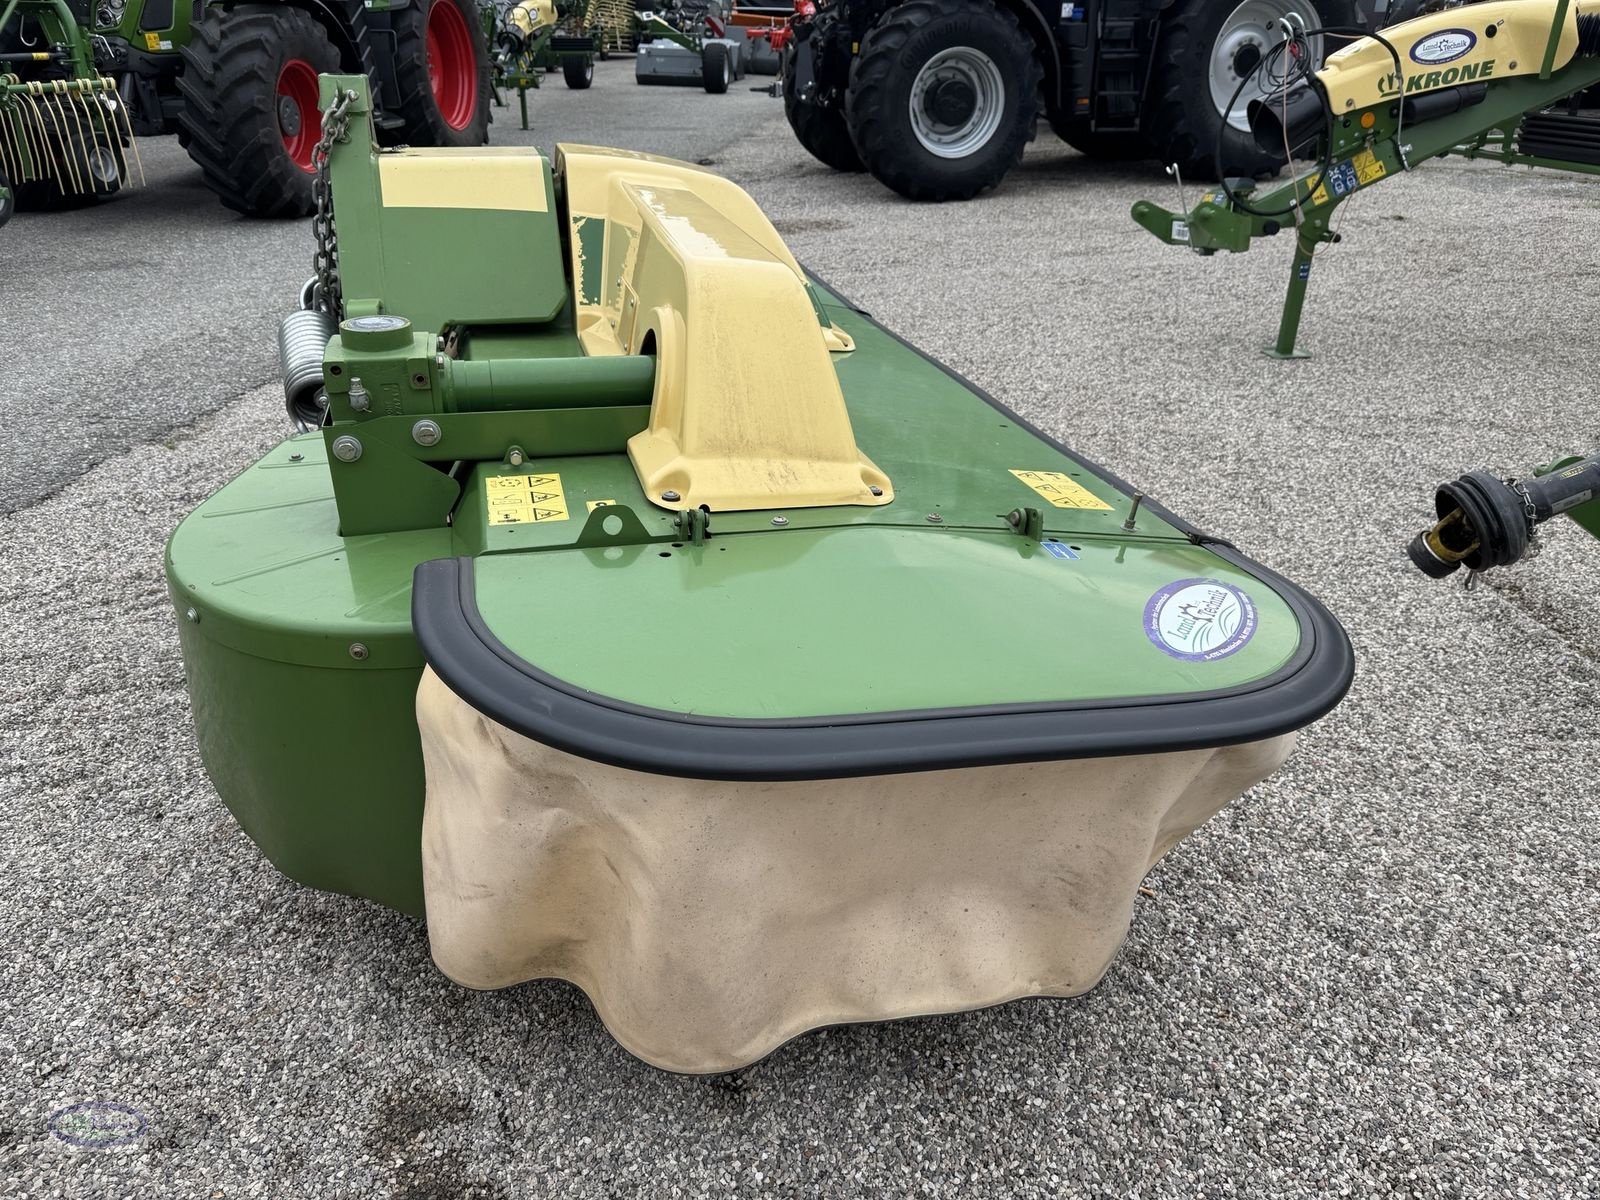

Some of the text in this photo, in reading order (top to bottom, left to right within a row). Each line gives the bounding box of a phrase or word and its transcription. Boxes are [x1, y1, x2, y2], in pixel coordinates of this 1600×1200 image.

[1422, 39, 1467, 51] Land Technik
[1405, 59, 1496, 93] KRONE
[1166, 614, 1197, 641] Land
[1197, 589, 1229, 618] Technik
